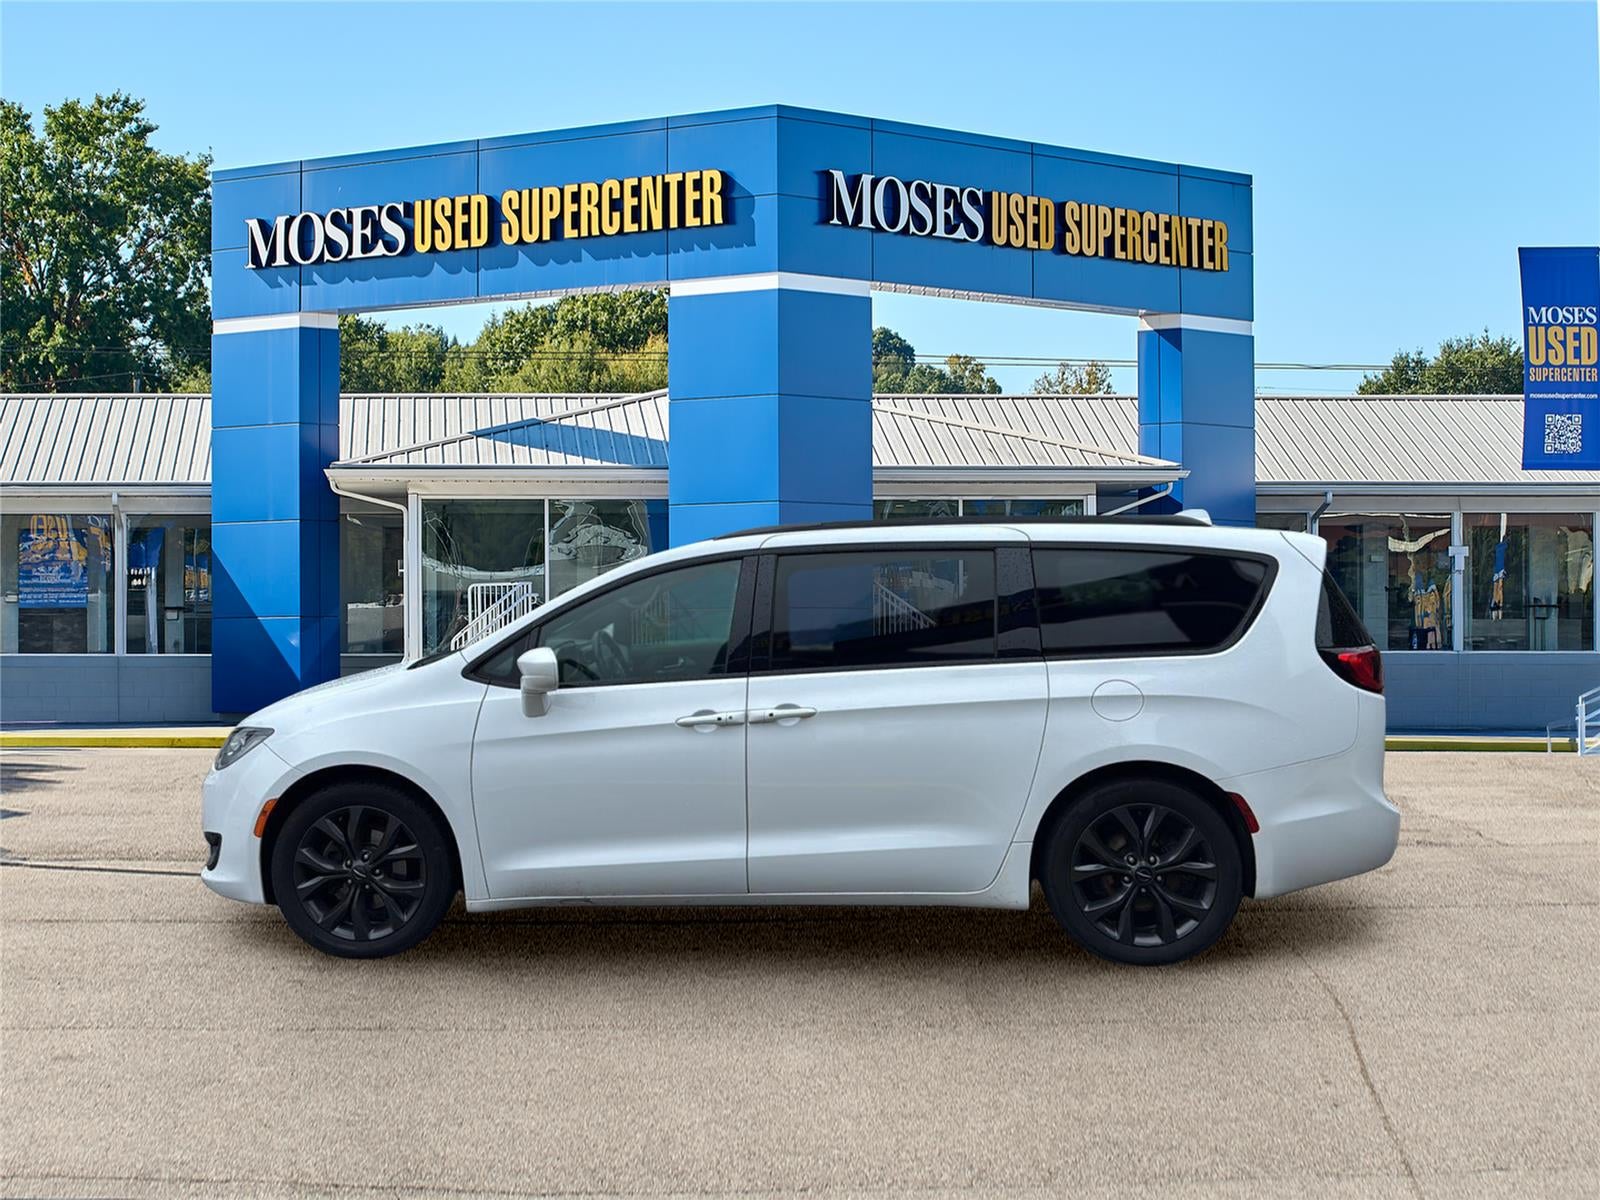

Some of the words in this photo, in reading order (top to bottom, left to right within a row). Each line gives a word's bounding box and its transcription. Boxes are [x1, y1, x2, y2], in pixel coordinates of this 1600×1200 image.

[245, 202, 407, 269] MOSES
[413, 195, 488, 253] USED
[501, 169, 723, 245] SUPERCENTER
[829, 169, 985, 242] MOSES
[991, 191, 1055, 250] USED
[1065, 201, 1229, 271] SUPERCENTER
[1528, 306, 1597, 325] MOSES
[1528, 326, 1598, 366] USED
[1529, 367, 1598, 382] SUPERCENTER
[1529, 392, 1598, 400] mosesusedsupercenter.com
